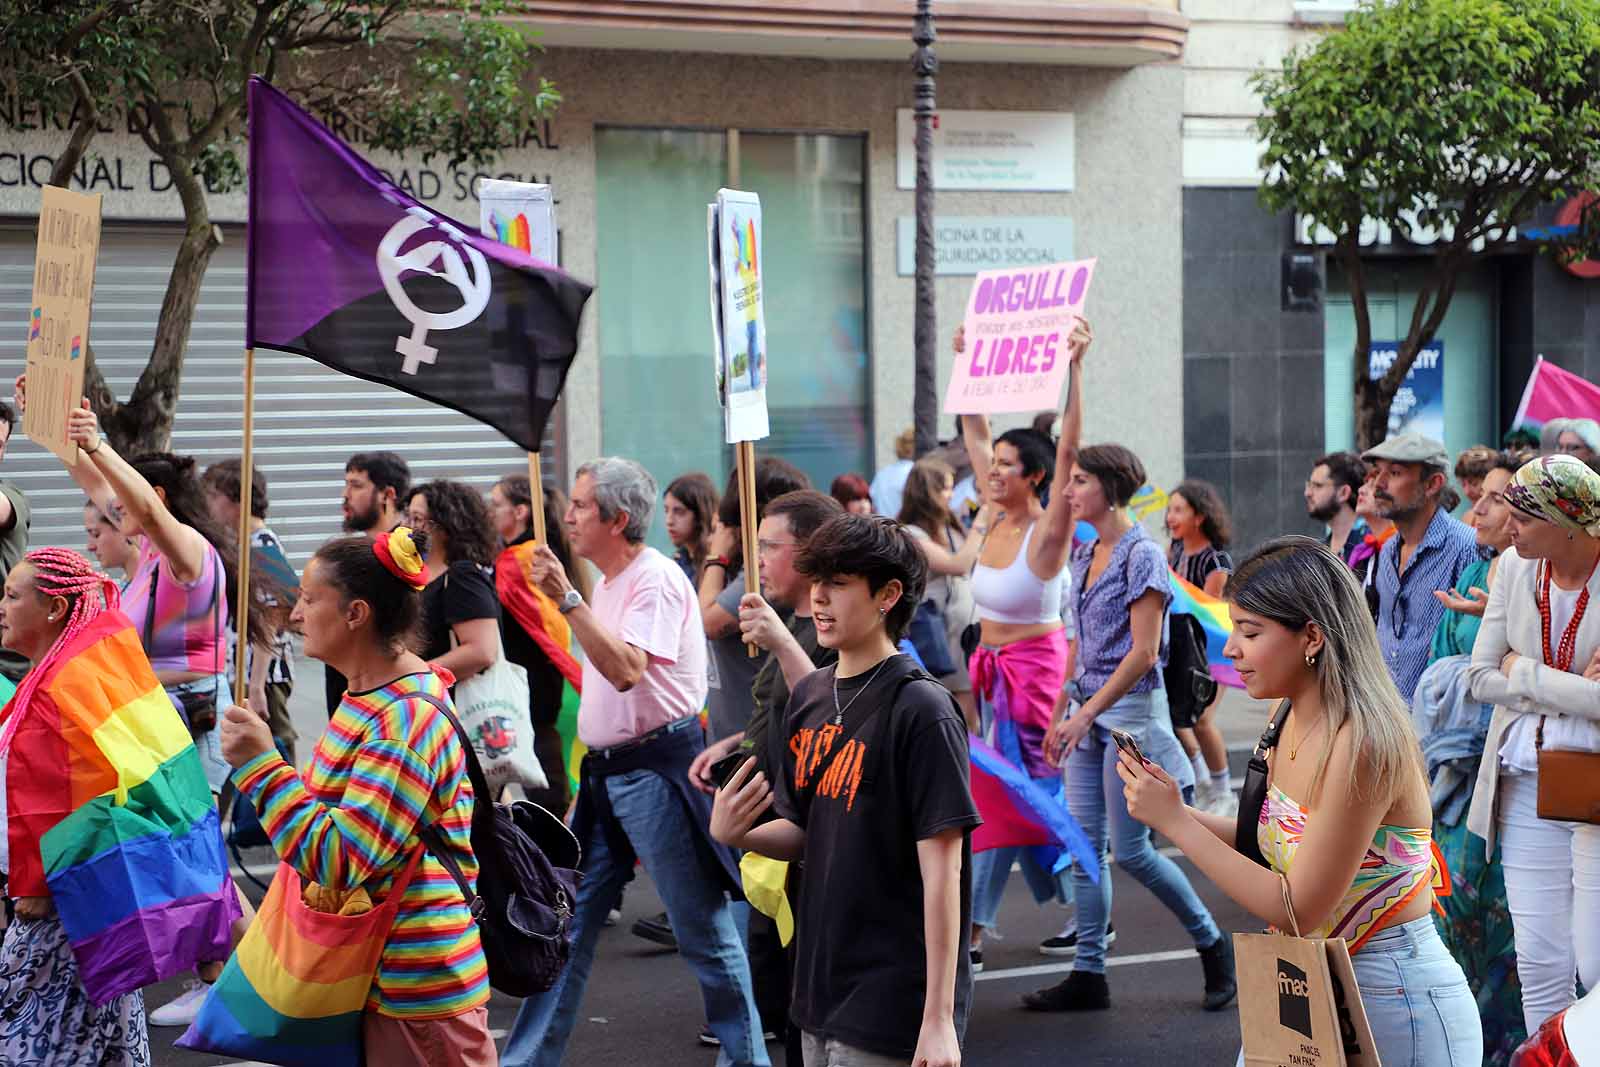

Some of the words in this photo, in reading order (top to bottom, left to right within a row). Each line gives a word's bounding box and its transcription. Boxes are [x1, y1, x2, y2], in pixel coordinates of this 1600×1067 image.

[936, 227, 979, 242] ICINA
[1007, 228, 1025, 242] LA
[936, 249, 1000, 264] GURIDAD
[1004, 250, 1056, 265] SOCIAL
[974, 266, 1088, 314] ORGULLO
[969, 332, 1059, 377] LIBRES
[1279, 971, 1311, 997] fnac
